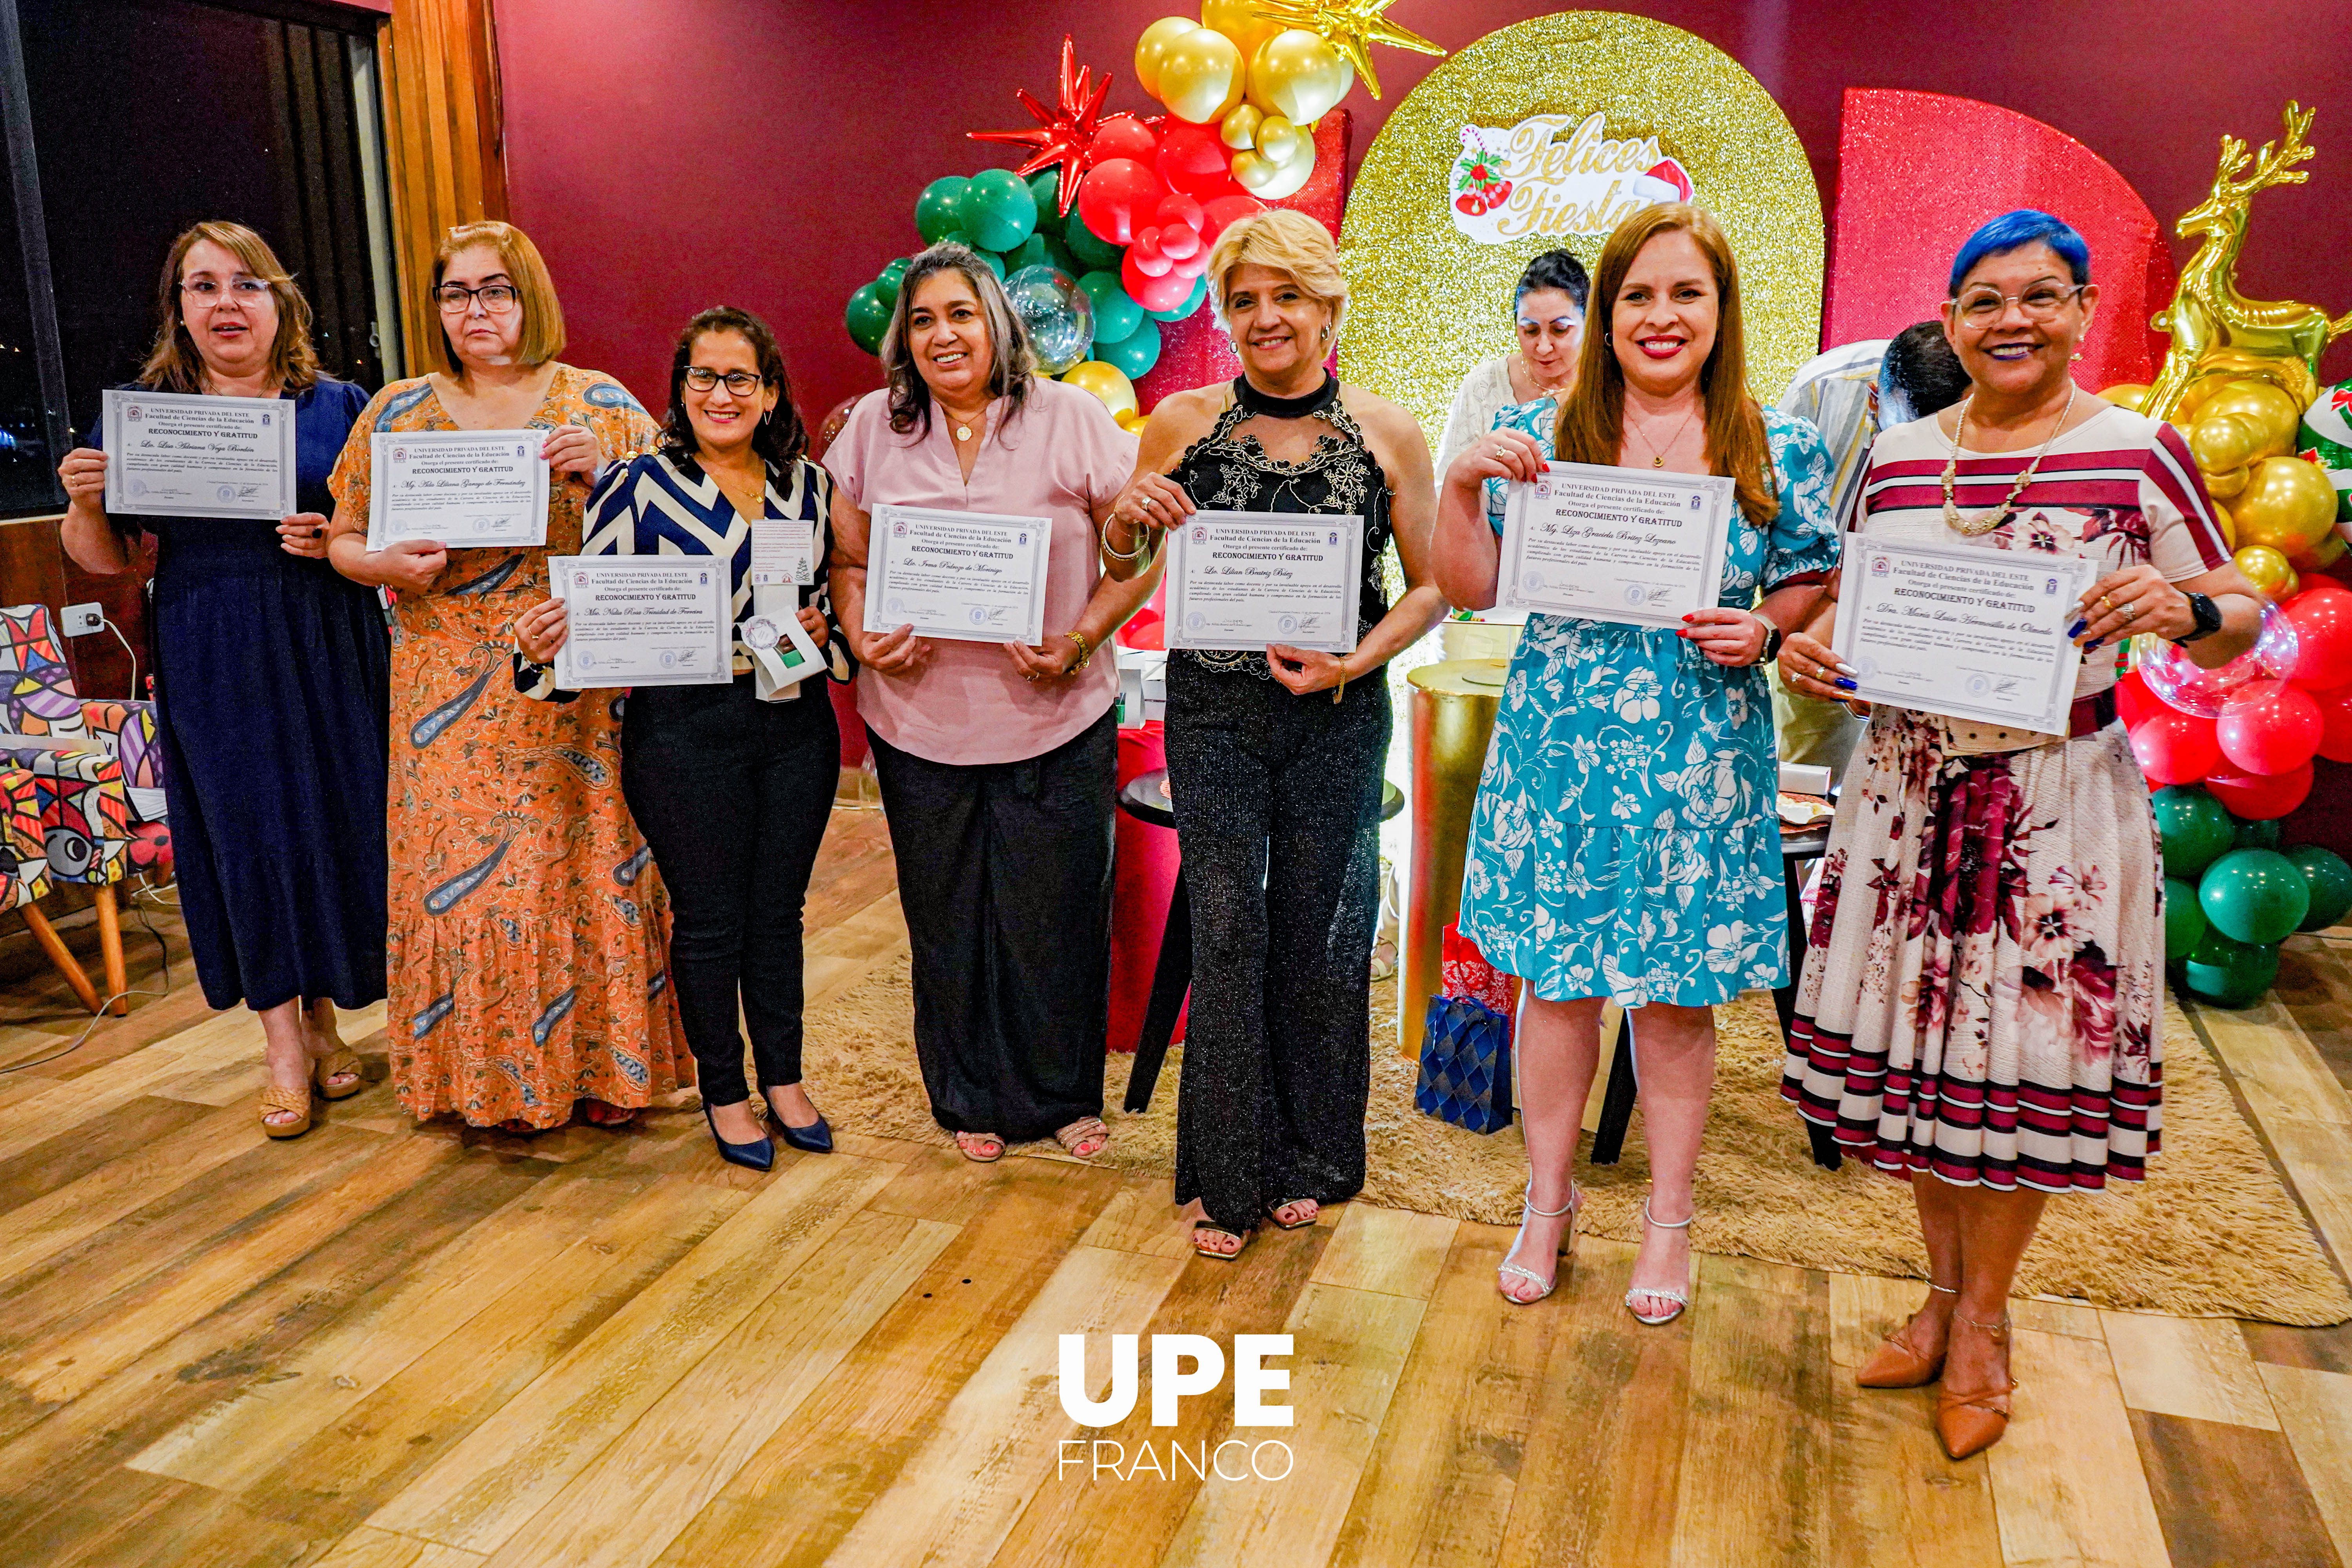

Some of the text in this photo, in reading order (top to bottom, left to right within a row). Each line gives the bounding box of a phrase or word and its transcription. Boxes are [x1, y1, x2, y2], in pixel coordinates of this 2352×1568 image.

[1499, 114, 1659, 177] Felices
[1497, 176, 1655, 236] Fiesta
[148, 428, 212, 437] RECONOCIMIENTO
[1561, 483, 1610, 492] UNIVERSIDAD
[1611, 487, 1641, 495] PRIVADA
[1554, 489, 1584, 498] Facultad
[1595, 493, 1624, 502] Ciencias
[1644, 497, 1681, 507] Educación
[1555, 508, 1628, 522] RECONOCIMIENTO
[1638, 516, 1682, 527] GRATITUD
[915, 524, 955, 532] UNIVERSIDAD
[1581, 526, 1614, 539] Graciela
[911, 545, 971, 556] RECONOCIMIENTO
[978, 551, 1013, 559] GRATITUD
[1212, 552, 1277, 560] RECONOCIMIENTO
[918, 559, 937, 568] Irma
[1900, 560, 1954, 572] UNIVERSIDAD
[1955, 566, 1990, 577] PRIVADA
[2009, 573, 2029, 581] ESTE
[1220, 566, 1243, 575] Lilian
[1244, 566, 1271, 579] Beatriz
[1272, 567, 1293, 579] Báez
[1892, 566, 1926, 577] Facultad
[1938, 572, 1971, 583] Ciencias
[1993, 579, 2034, 591] Educación
[1894, 587, 2035, 613] RECONOCIMIENTO Y GRATITUD
